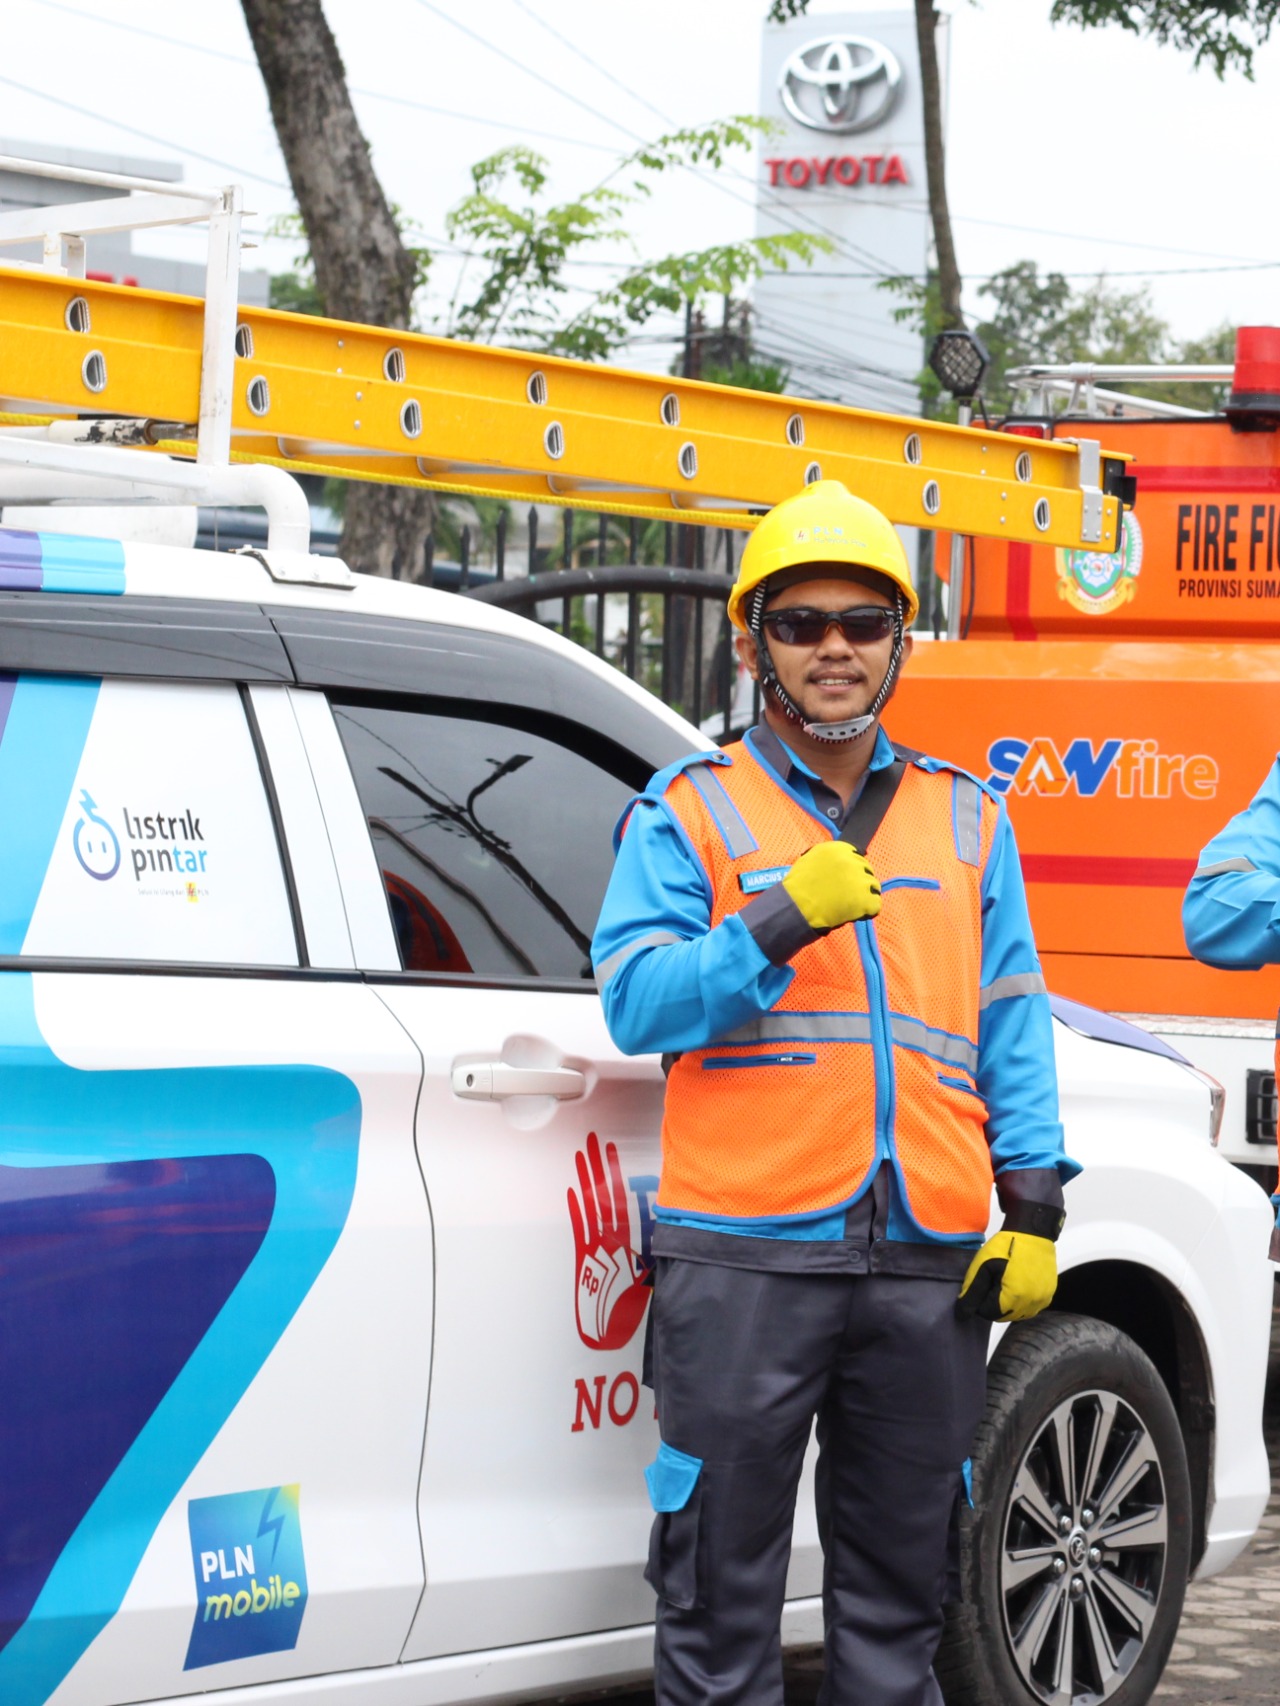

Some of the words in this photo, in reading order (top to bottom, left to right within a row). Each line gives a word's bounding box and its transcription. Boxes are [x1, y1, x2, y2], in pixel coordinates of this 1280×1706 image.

[764, 154, 909, 188] TOYOTA
[1176, 504, 1239, 571] FIRE
[1179, 579, 1241, 597] PROVINSI
[746, 872, 782, 886] MARCIUS
[582, 1265, 599, 1296] Rp
[571, 1371, 639, 1432] NO
[200, 1544, 255, 1583] PLN
[203, 1574, 300, 1622] mobile
